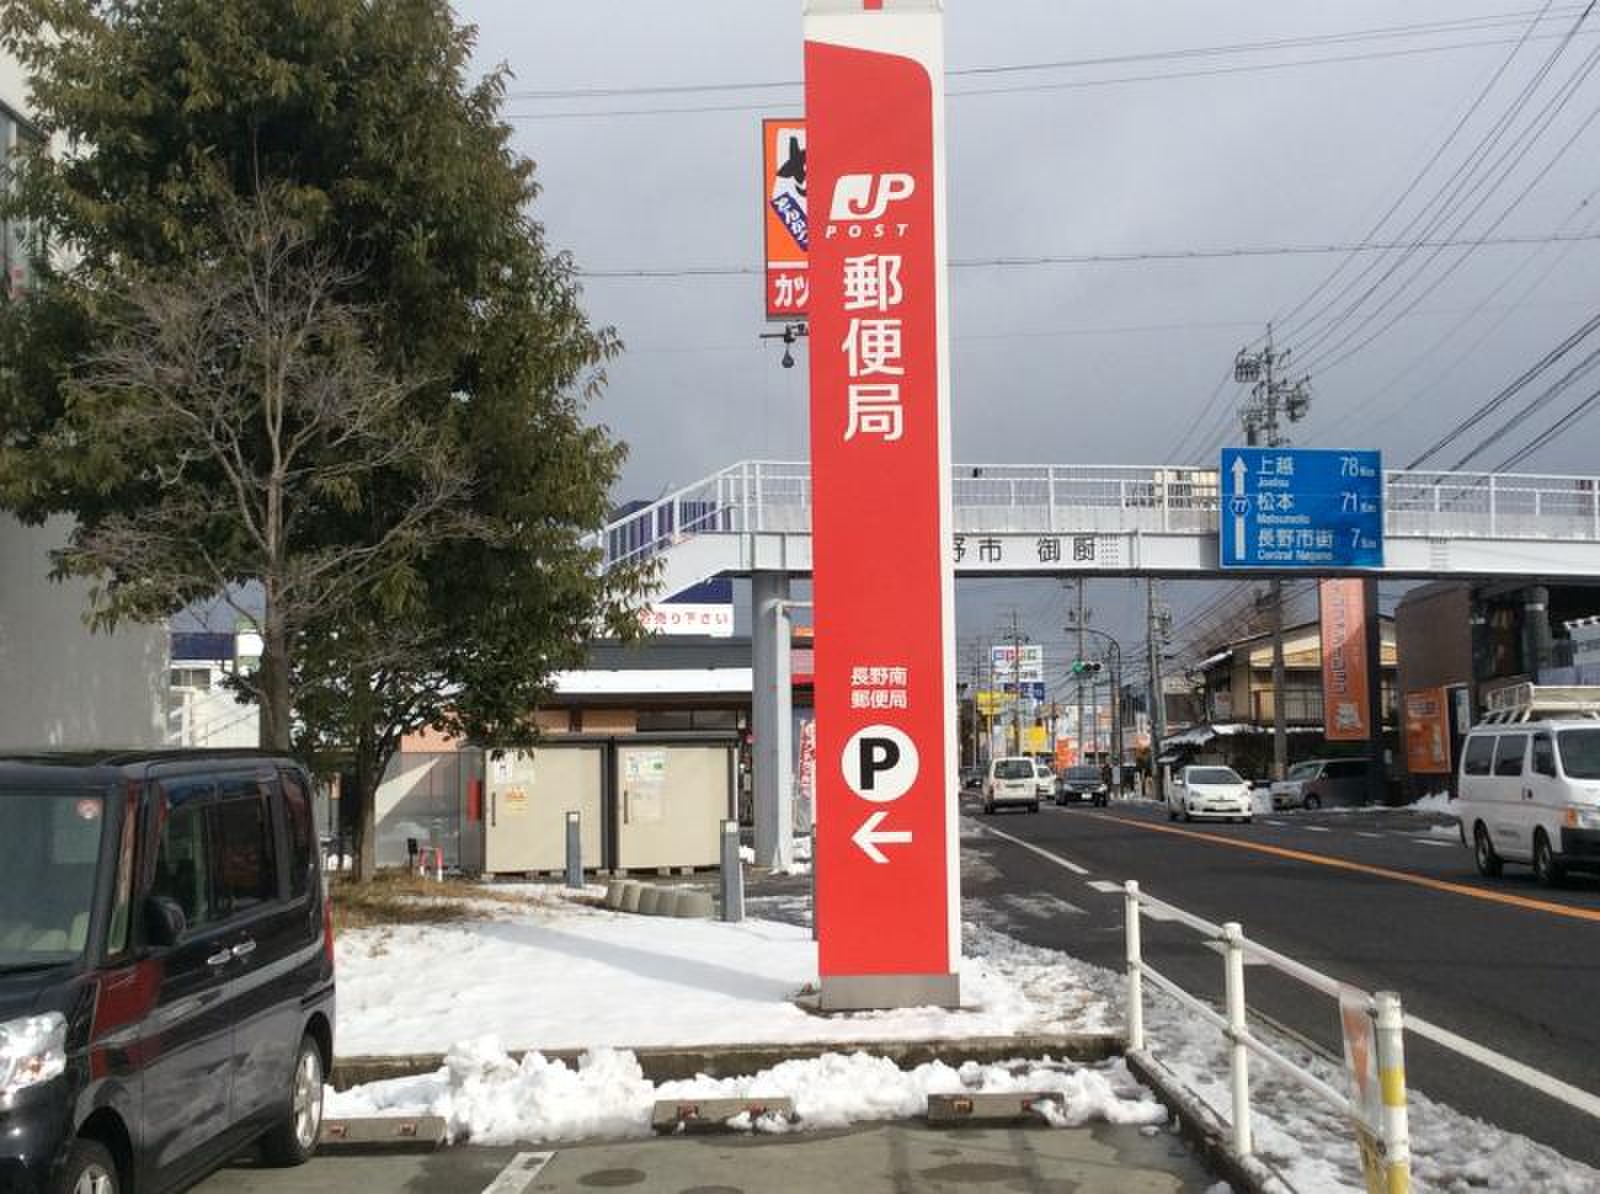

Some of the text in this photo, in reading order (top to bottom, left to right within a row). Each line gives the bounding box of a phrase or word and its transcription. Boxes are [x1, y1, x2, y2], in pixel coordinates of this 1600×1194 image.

[829, 173, 915, 221] JP
[825, 223, 909, 239] POST
[842, 254, 905, 441] 郵便局
[1256, 455, 1294, 476] 上越
[1339, 457, 1358, 477] 78
[1256, 492, 1294, 512] 松本
[1340, 492, 1357, 512] 71
[1257, 528, 1333, 549] 長野市街
[1351, 528, 1361, 548] 7
[851, 666, 908, 686] 長野南
[851, 689, 908, 709] 郵便局
[860, 737, 900, 790] P
